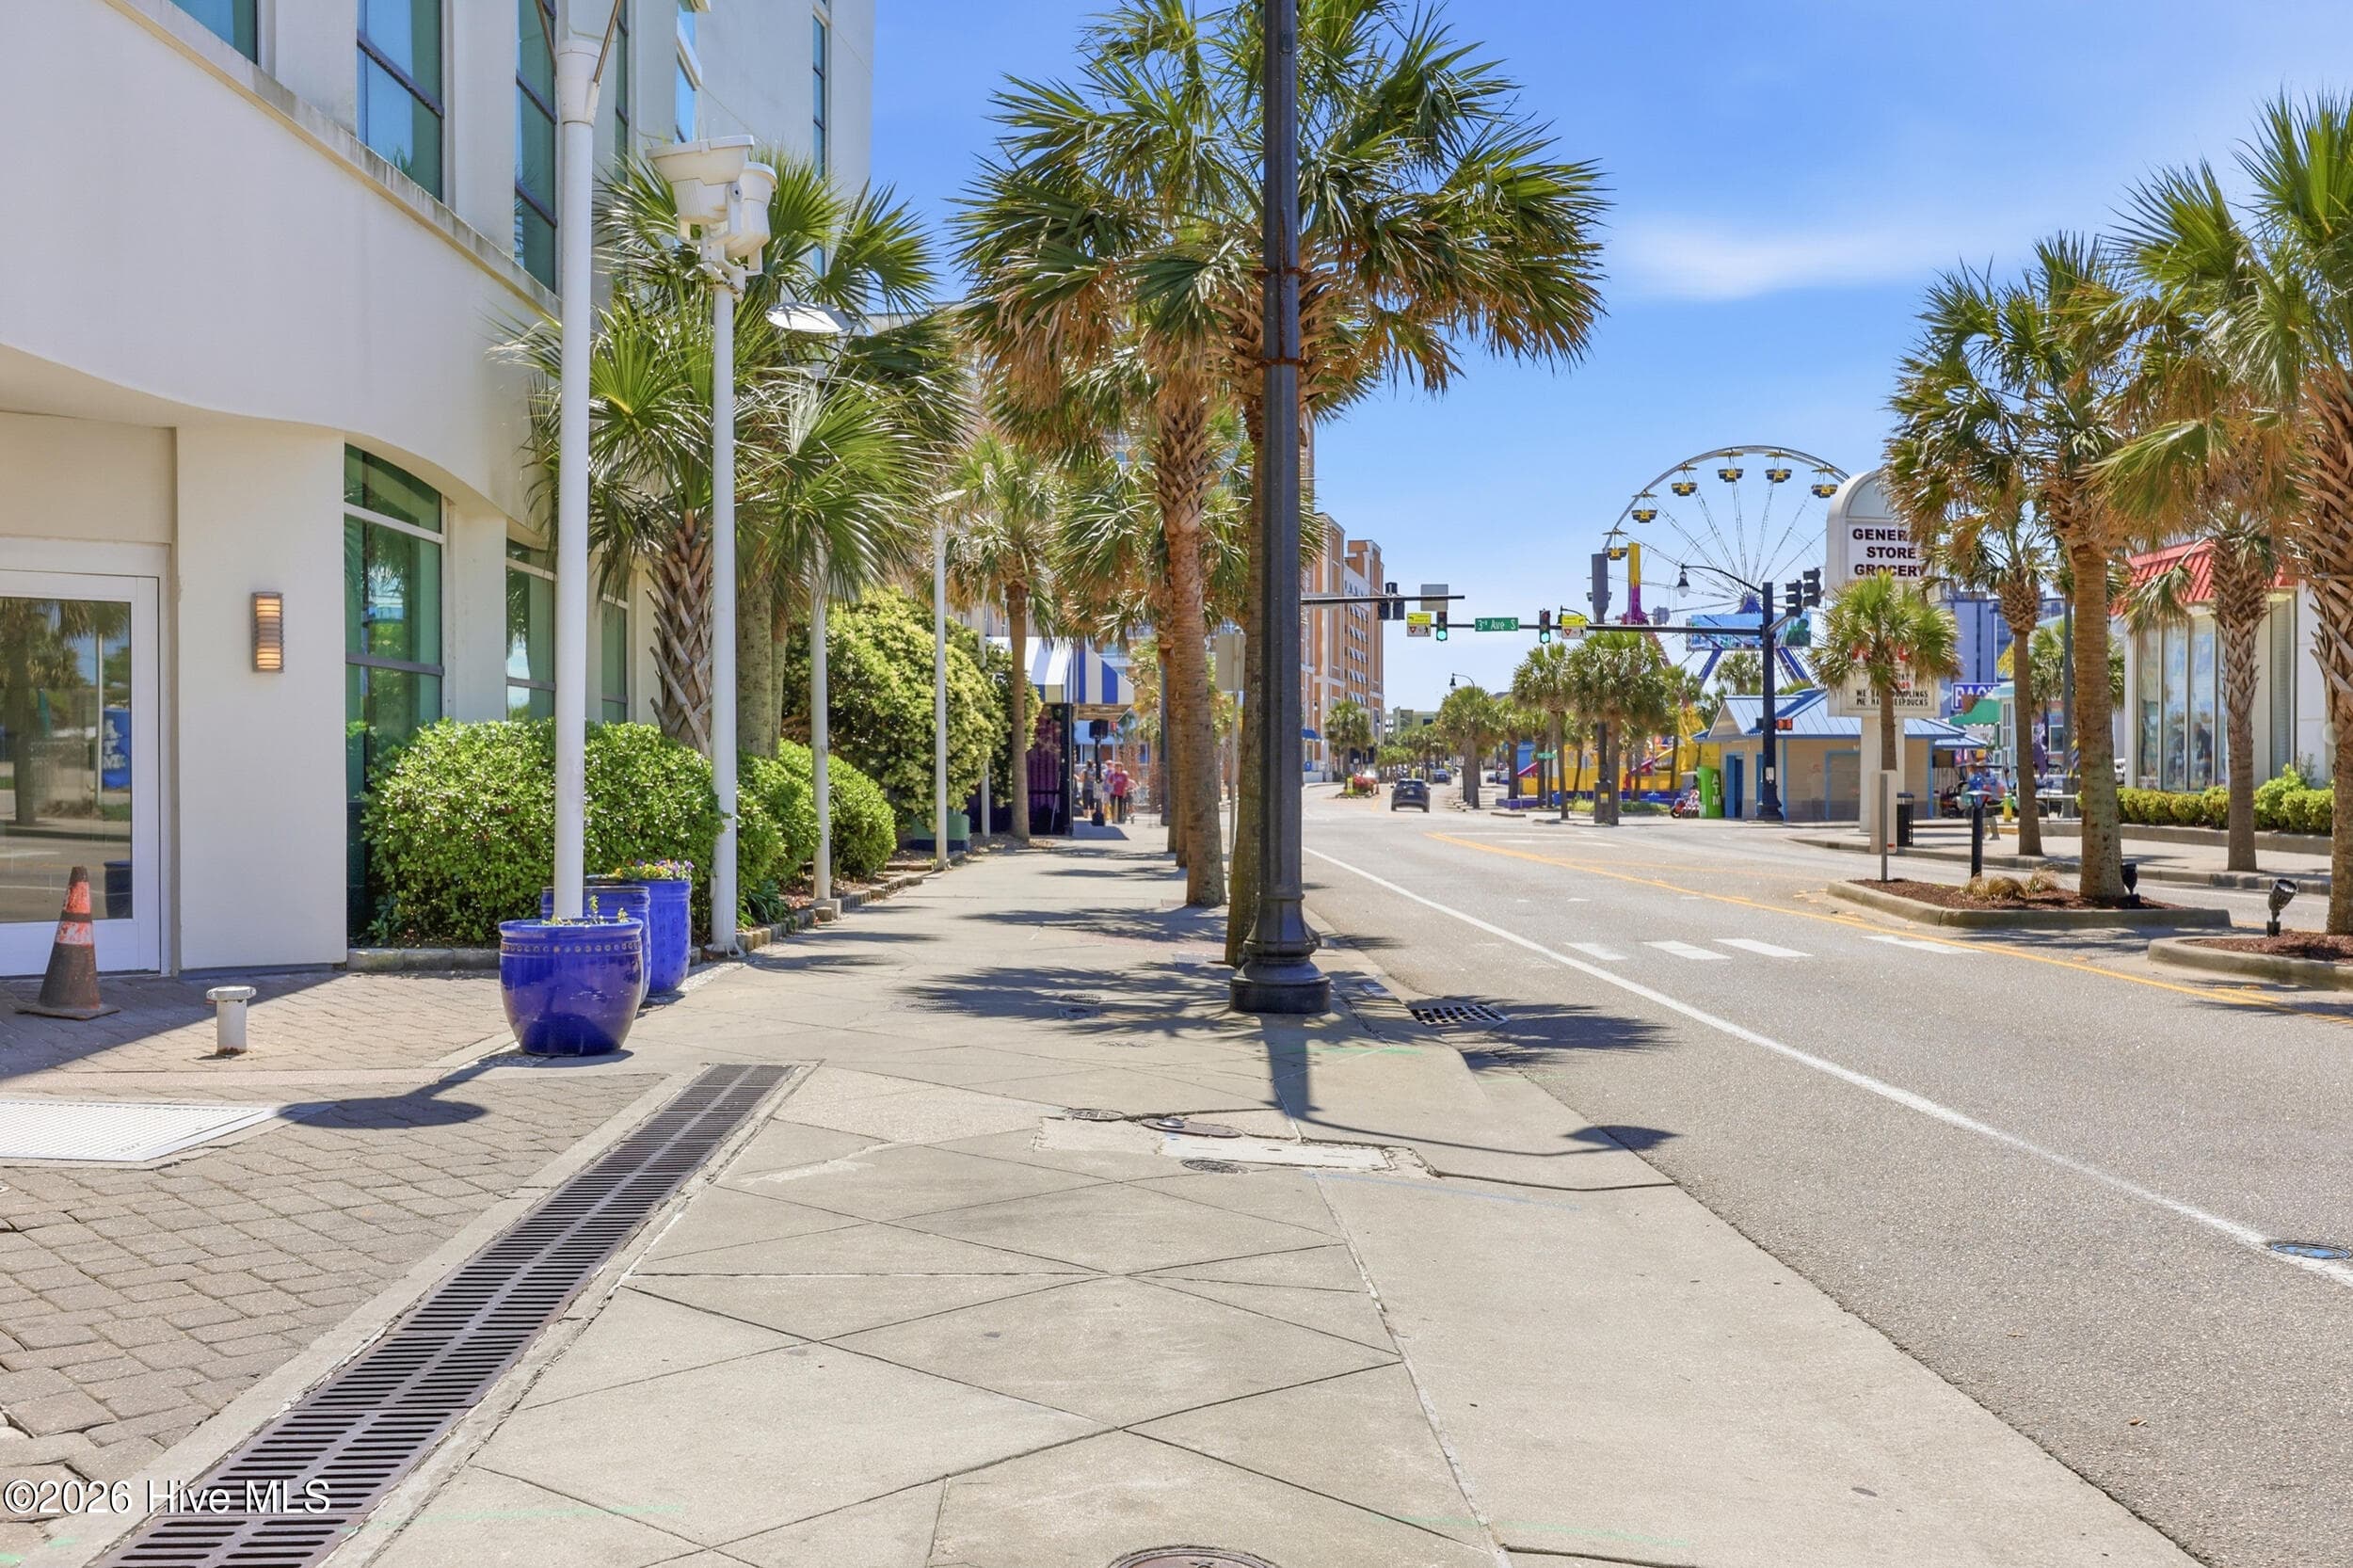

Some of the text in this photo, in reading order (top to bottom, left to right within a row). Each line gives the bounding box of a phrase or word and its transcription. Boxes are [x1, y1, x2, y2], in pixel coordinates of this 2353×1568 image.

[1852, 528, 1910, 541] GENER
[1866, 546, 1916, 559] STORE
[1854, 564, 1924, 577] GROCERY
[1491, 619, 1505, 631] Ave
[1510, 619, 1516, 630] S
[1712, 773, 1721, 807] ATM
